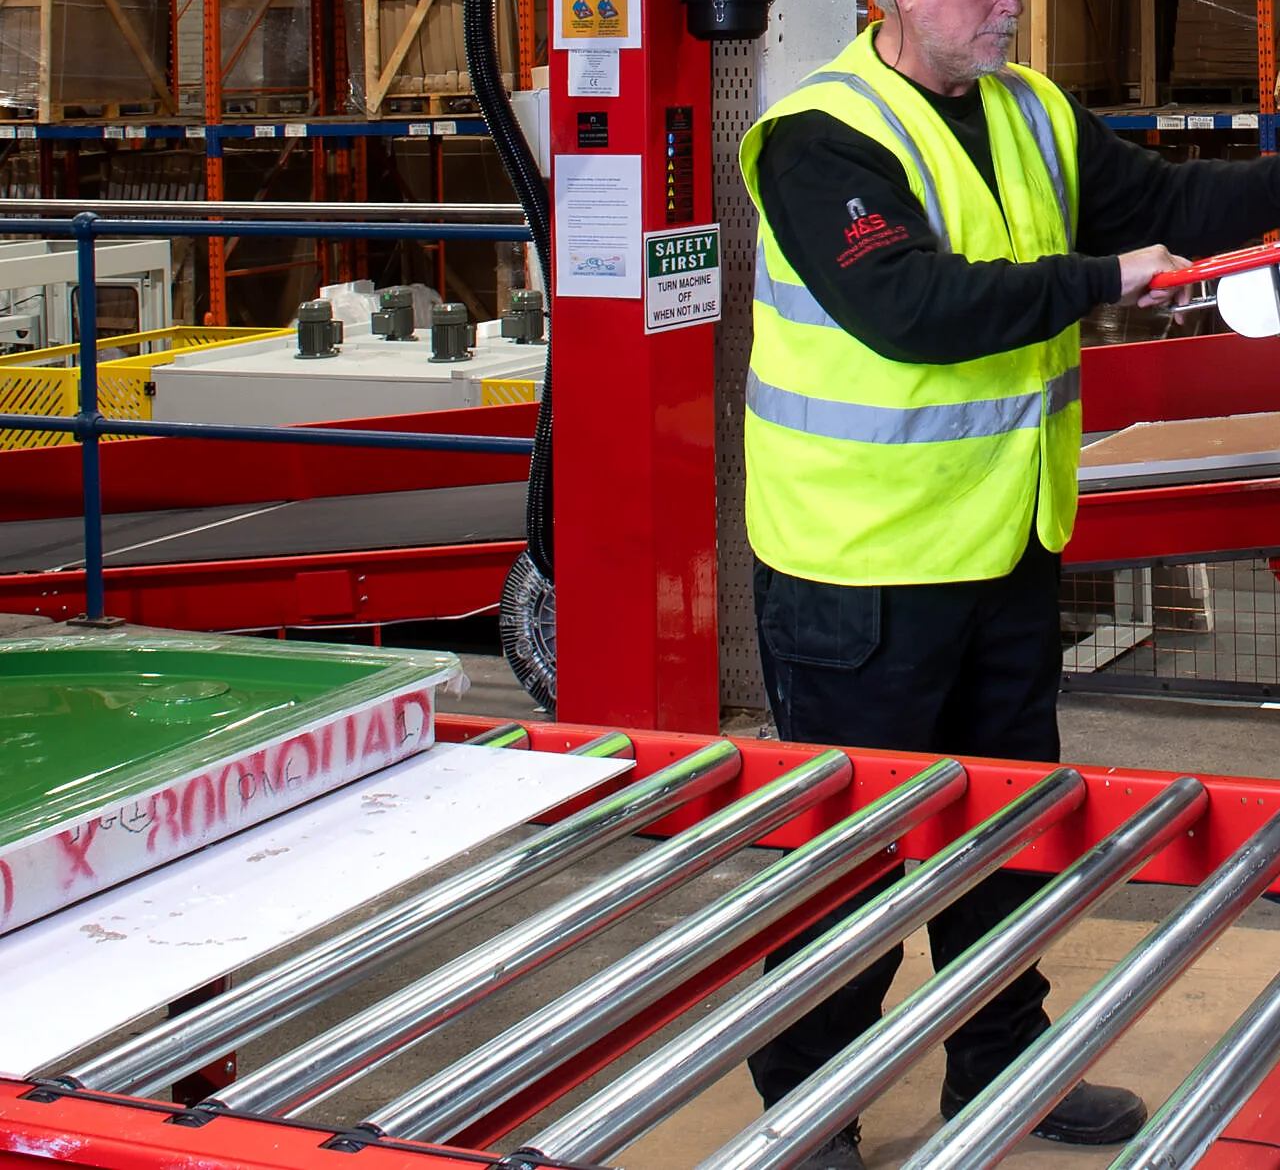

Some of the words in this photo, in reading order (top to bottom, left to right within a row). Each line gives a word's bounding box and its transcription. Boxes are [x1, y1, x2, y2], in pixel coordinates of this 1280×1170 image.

[843, 213, 887, 245] H&S
[655, 236, 713, 257] SAFETY
[662, 253, 706, 273] FIRST
[658, 281, 677, 292] TURN
[679, 274, 711, 288] MACHINE
[678, 291, 692, 303] OFF
[653, 308, 675, 321] WHEN
[676, 304, 692, 317] NOT
[692, 303, 700, 313] IN
[701, 300, 716, 312] USE
